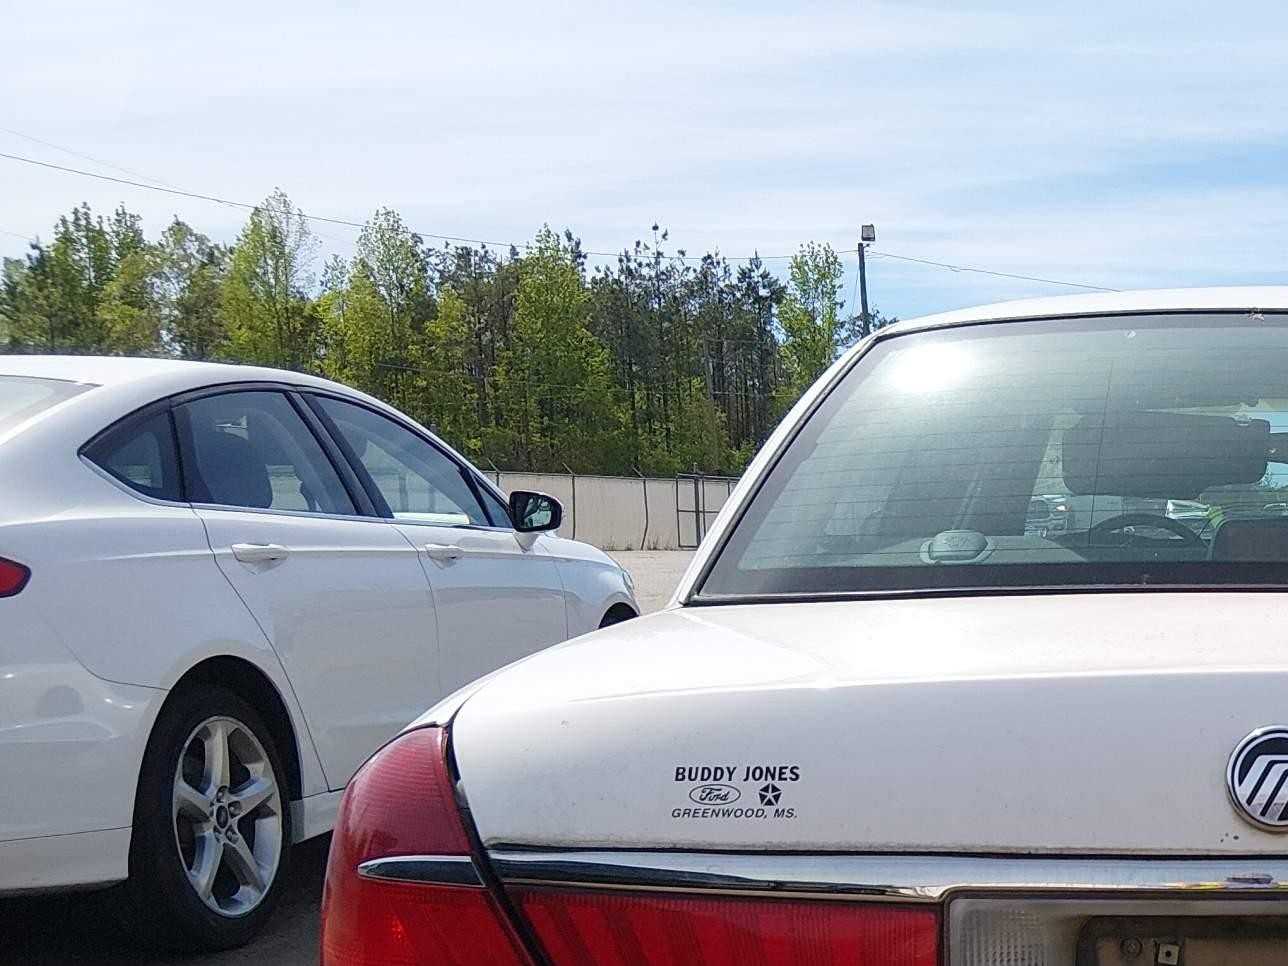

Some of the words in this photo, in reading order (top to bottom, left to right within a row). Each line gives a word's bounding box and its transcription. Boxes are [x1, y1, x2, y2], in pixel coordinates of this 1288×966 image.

[674, 766, 737, 782] BUDDY
[743, 765, 800, 782] JONES
[699, 787, 730, 802] Ford
[671, 807, 768, 819] GREENWOOD,
[773, 807, 798, 819] MS.
